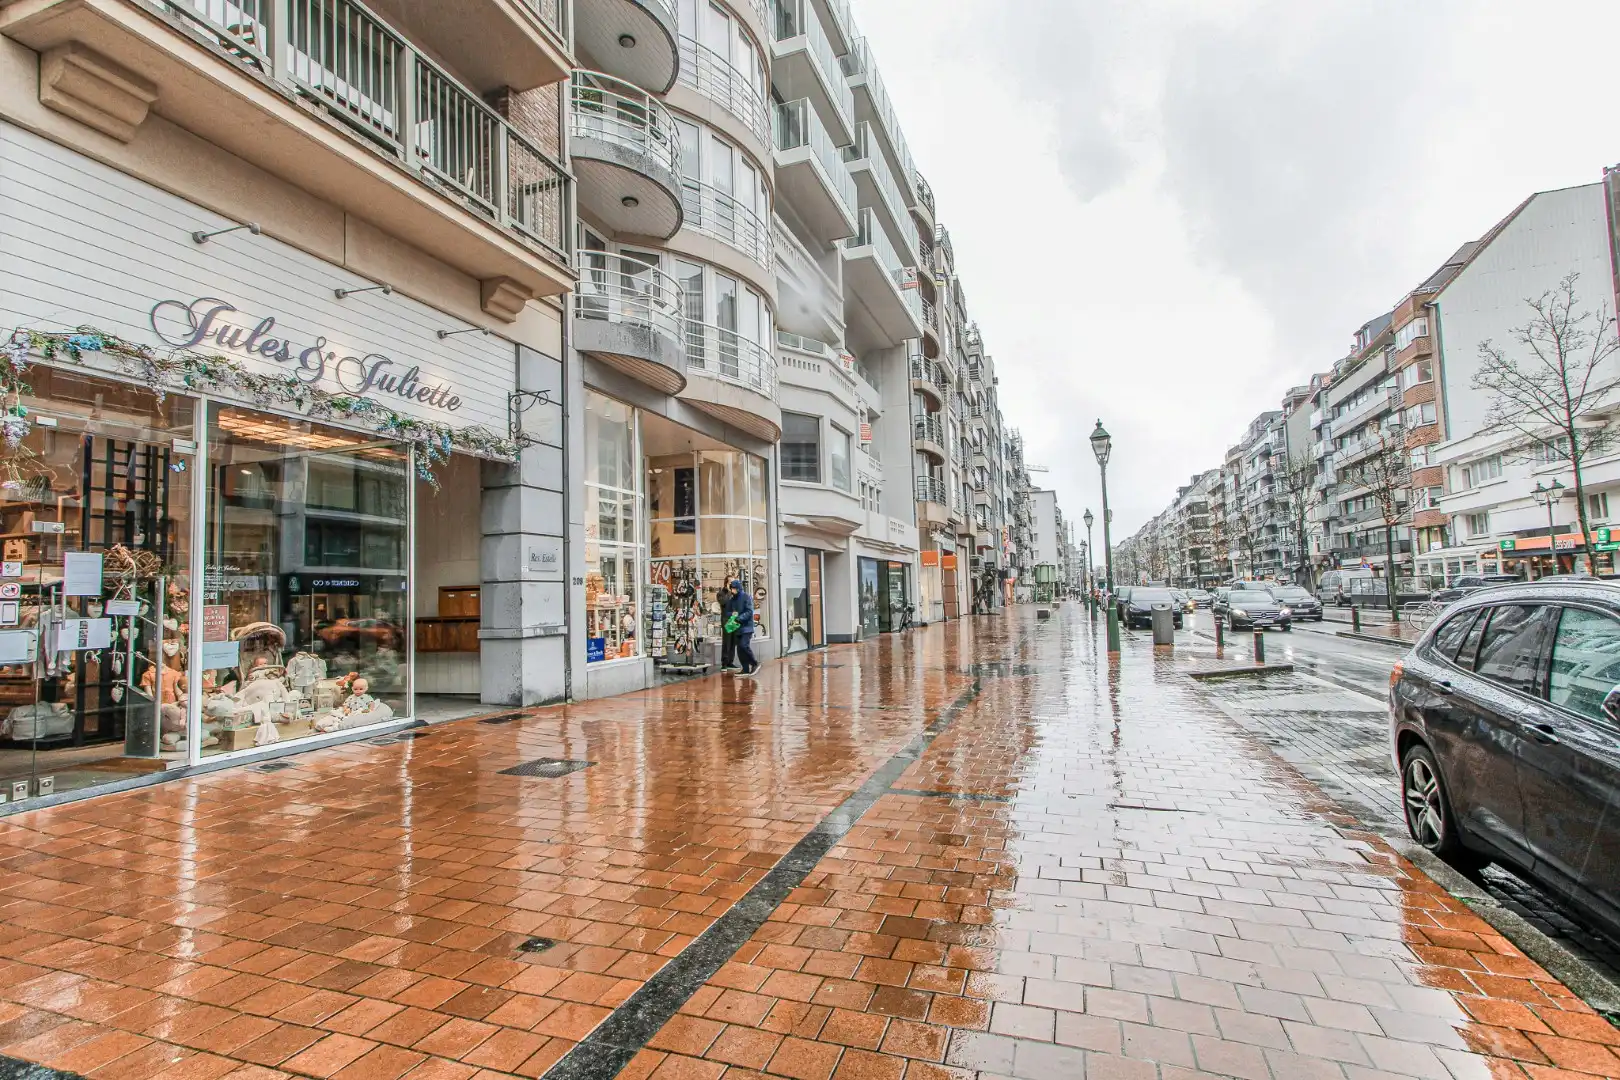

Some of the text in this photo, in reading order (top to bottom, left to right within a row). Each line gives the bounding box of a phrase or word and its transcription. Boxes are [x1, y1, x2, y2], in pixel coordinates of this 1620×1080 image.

[150, 297, 463, 412] Jules & Juliette
